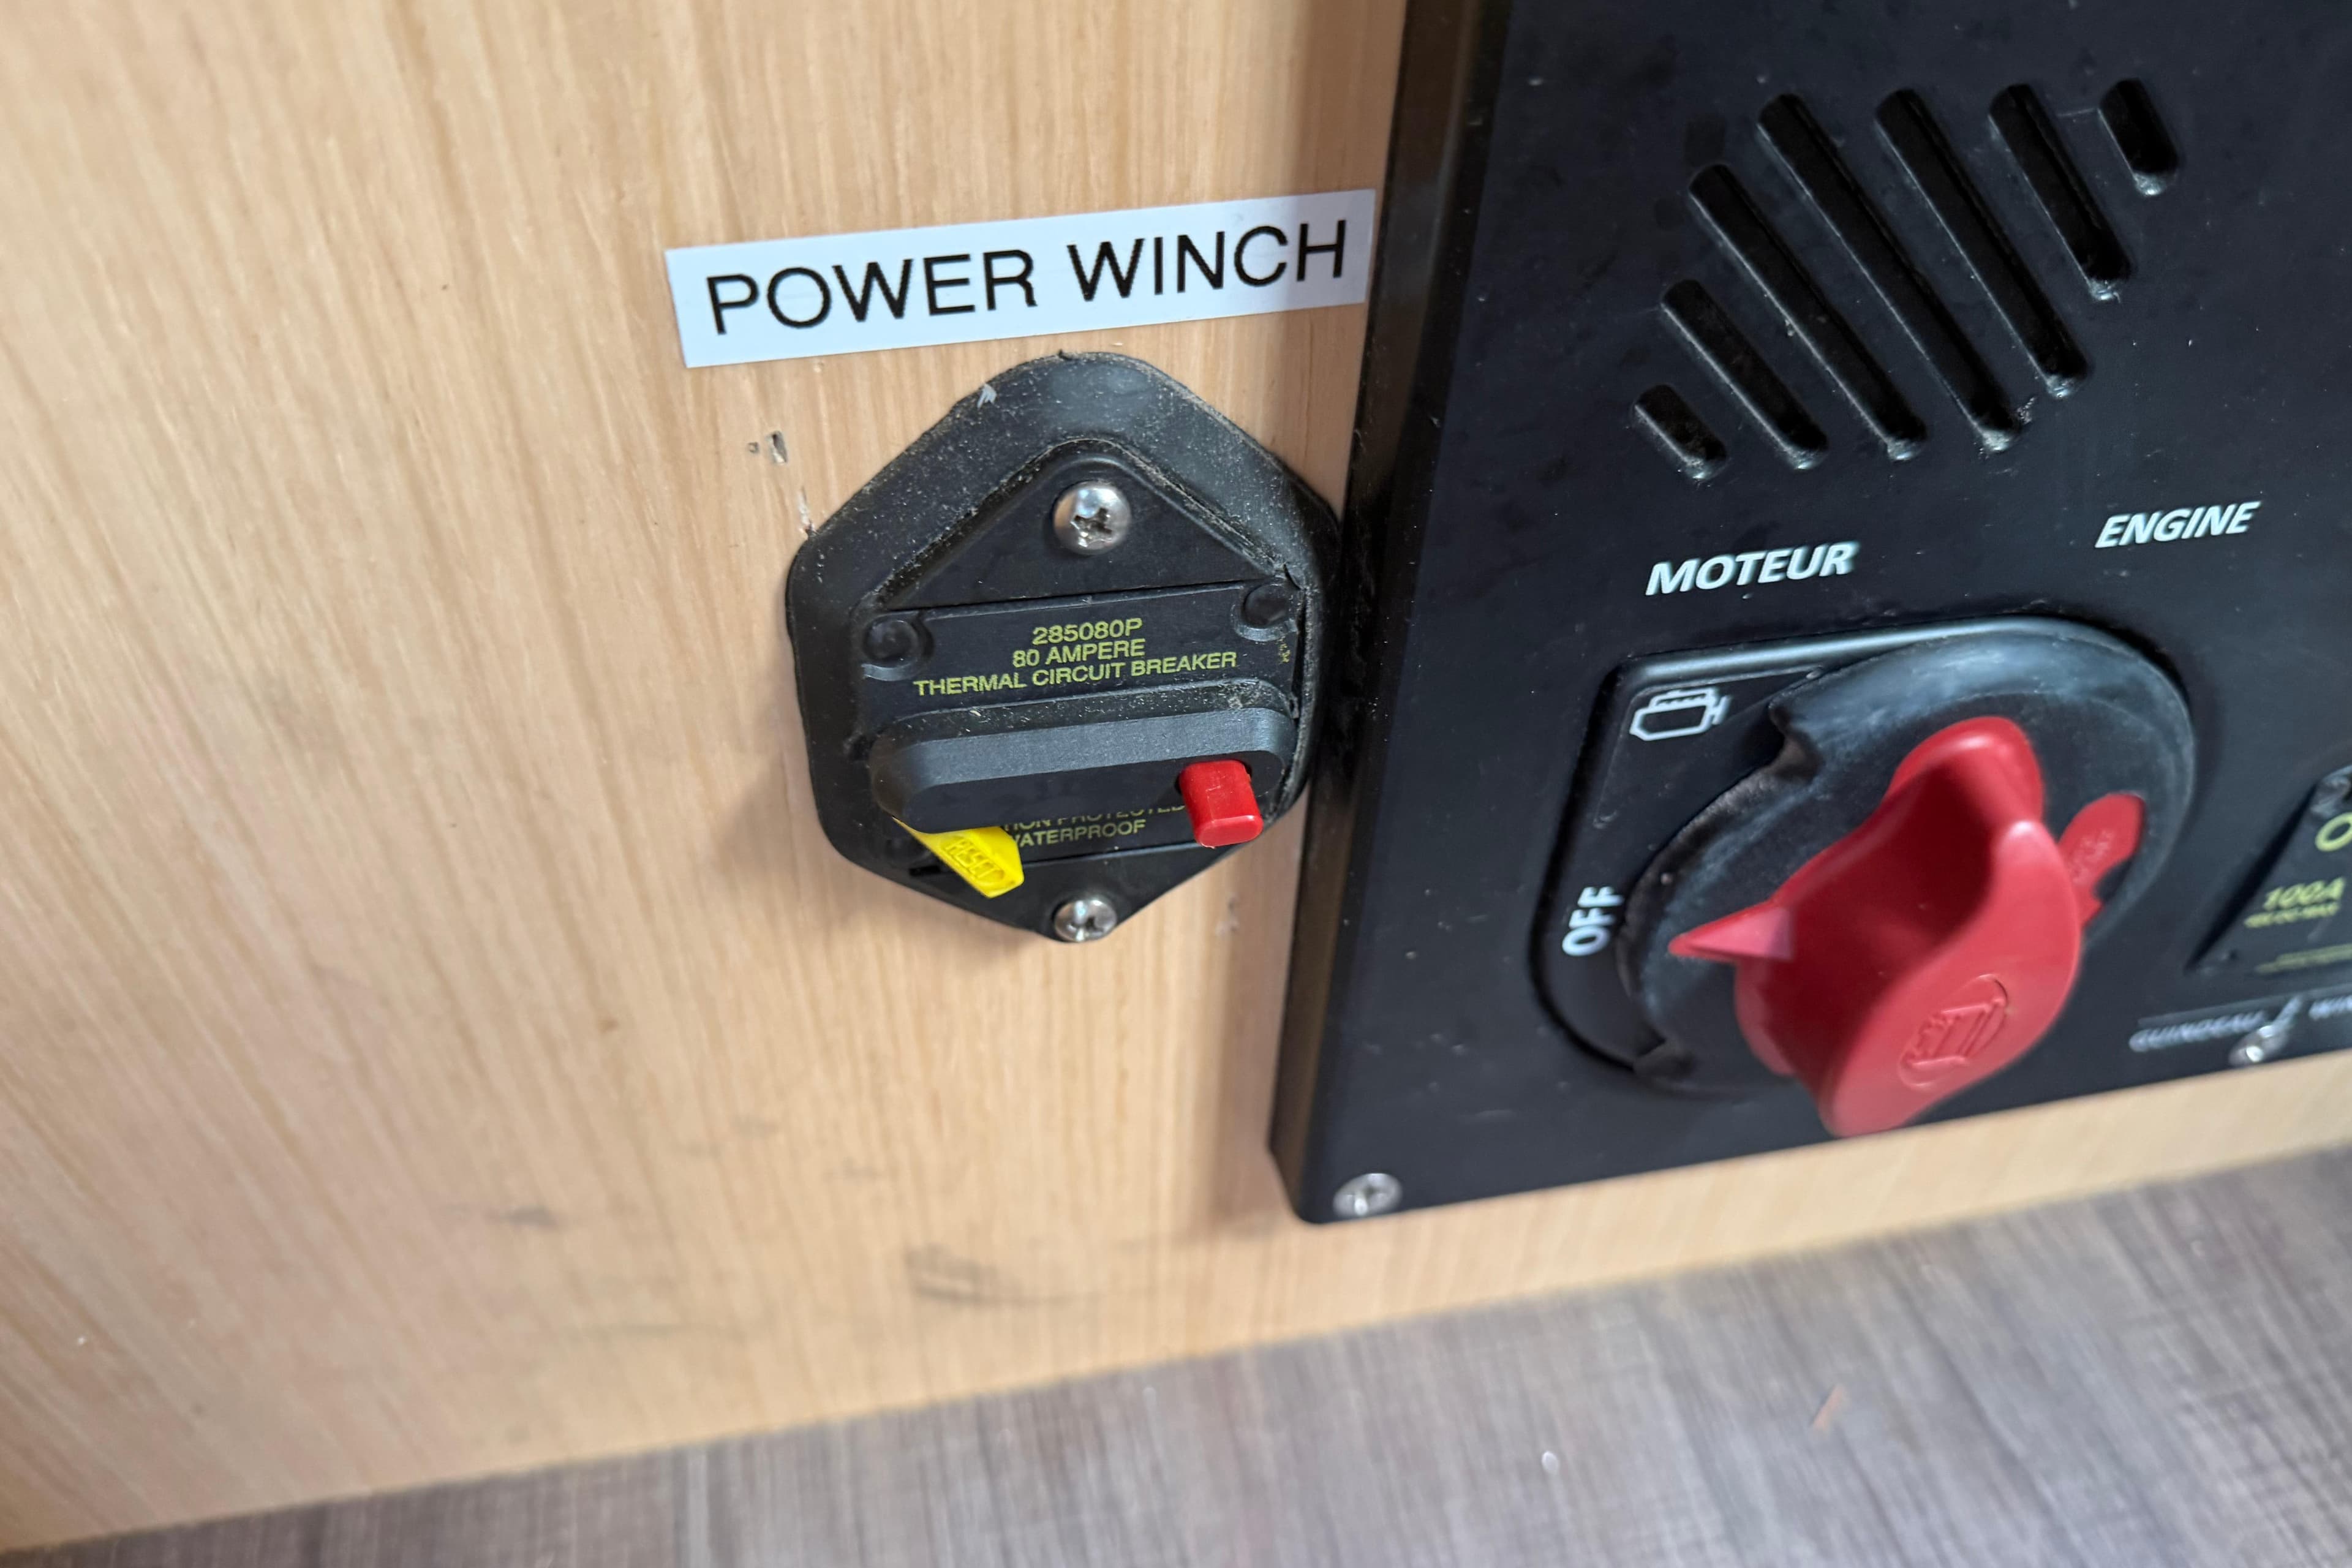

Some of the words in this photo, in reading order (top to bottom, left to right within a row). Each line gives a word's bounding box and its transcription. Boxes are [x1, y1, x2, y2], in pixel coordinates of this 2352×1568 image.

[706, 249, 1036, 334] POWER
[1066, 219, 1347, 301] WINCH
[2094, 500, 2261, 548] ENGINE
[1645, 541, 1858, 597] MOTEUR
[1013, 649, 1040, 668] 80
[1046, 638, 1145, 665] AMPERE
[1032, 618, 1143, 646] 285080P
[913, 674, 1026, 696] THERMAL
[1031, 662, 1125, 687] CIRCUIT
[1131, 652, 1237, 676] BREAKER
[1562, 886, 1624, 957] OFF
